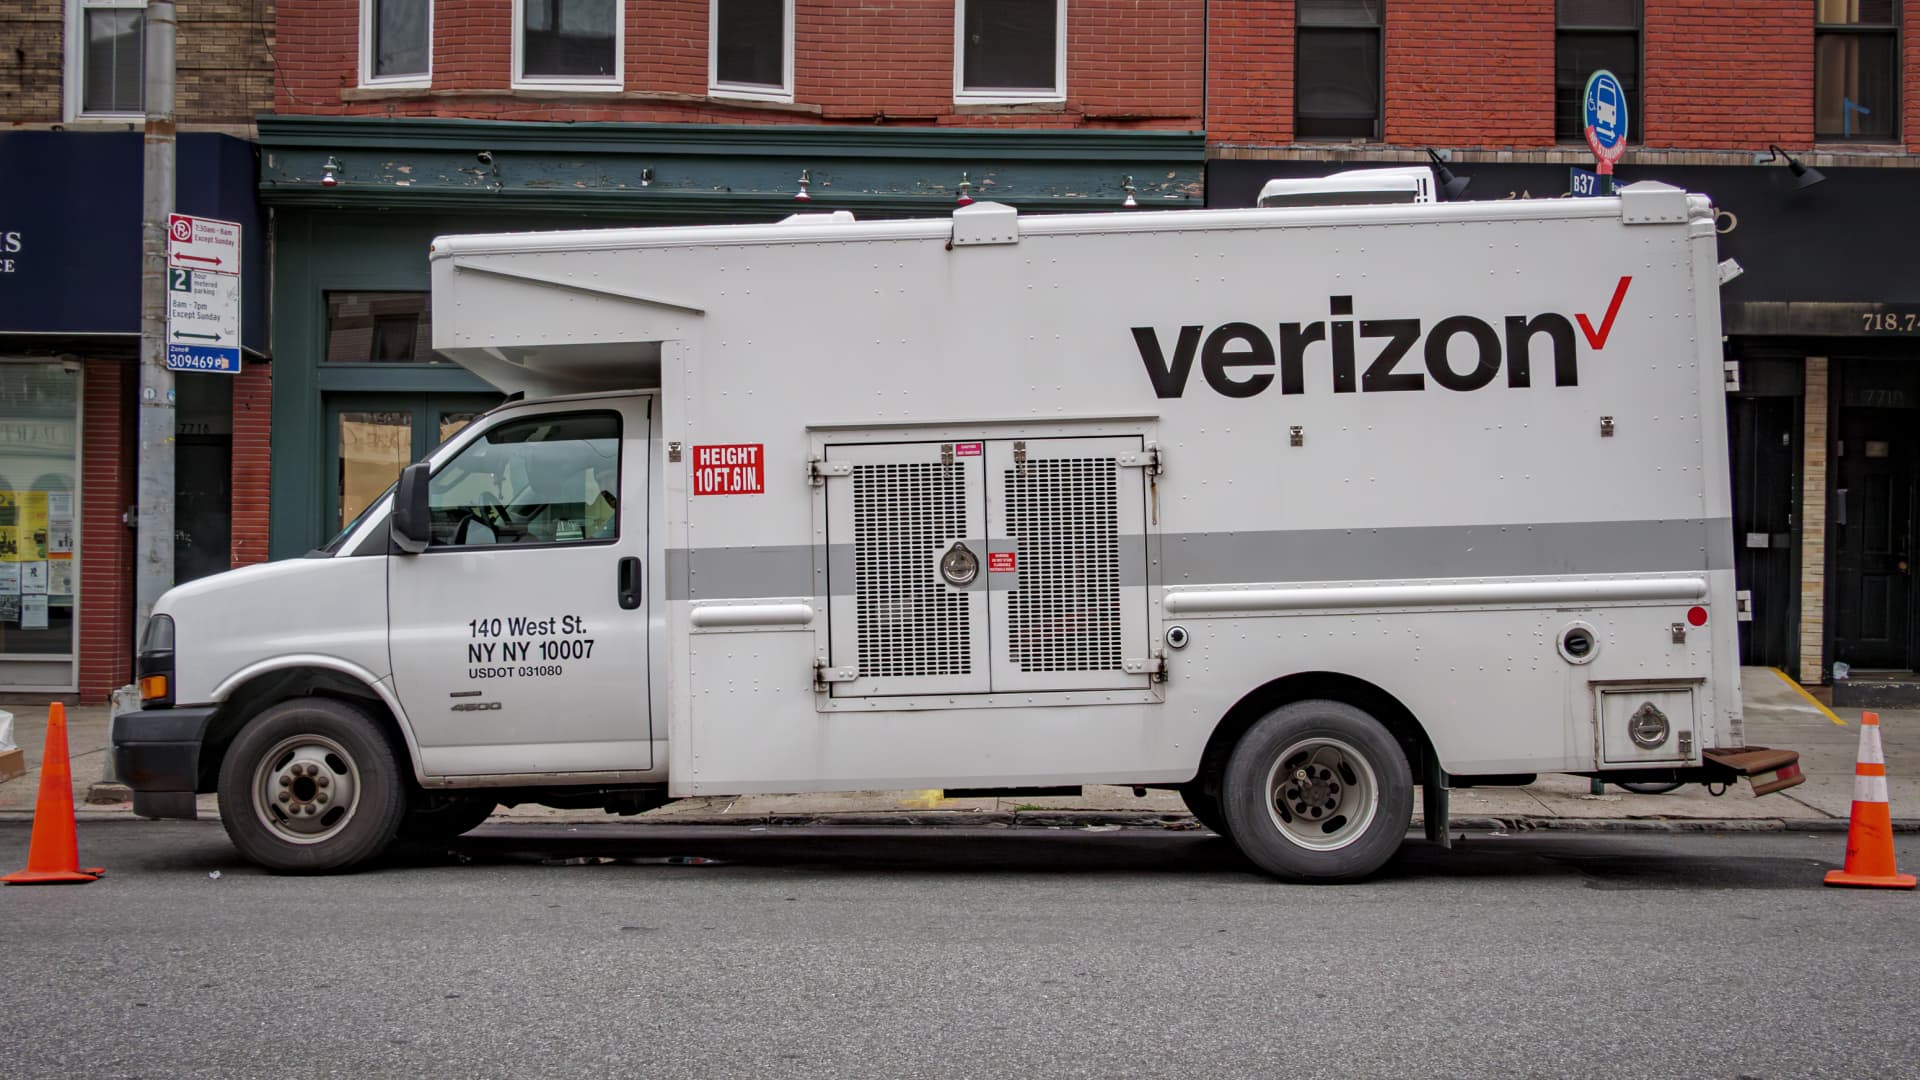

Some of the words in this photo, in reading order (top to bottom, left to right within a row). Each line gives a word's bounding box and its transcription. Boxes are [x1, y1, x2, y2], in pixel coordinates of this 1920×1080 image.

[1574, 174, 1594, 195] B37
[220, 228, 232, 236] 8am
[194, 234, 214, 244] Except
[215, 237, 234, 247] Sunday
[175, 270, 186, 290] 2
[194, 288, 216, 296] parking
[172, 300, 187, 308] 8am
[194, 301, 208, 310] 7pm
[172, 309, 195, 319] Except
[197, 312, 220, 322] Sunday
[1130, 295, 1579, 399] verizon
[170, 354, 214, 368] 309469
[700, 448, 757, 465] HEIGHT
[469, 618, 501, 638] 140
[508, 617, 556, 636] West
[562, 615, 587, 634] St.
[468, 643, 496, 663] NY
[503, 642, 530, 661] NY
[539, 640, 594, 660] 10007
[469, 667, 514, 678] USDOT
[518, 666, 562, 677] 031080
